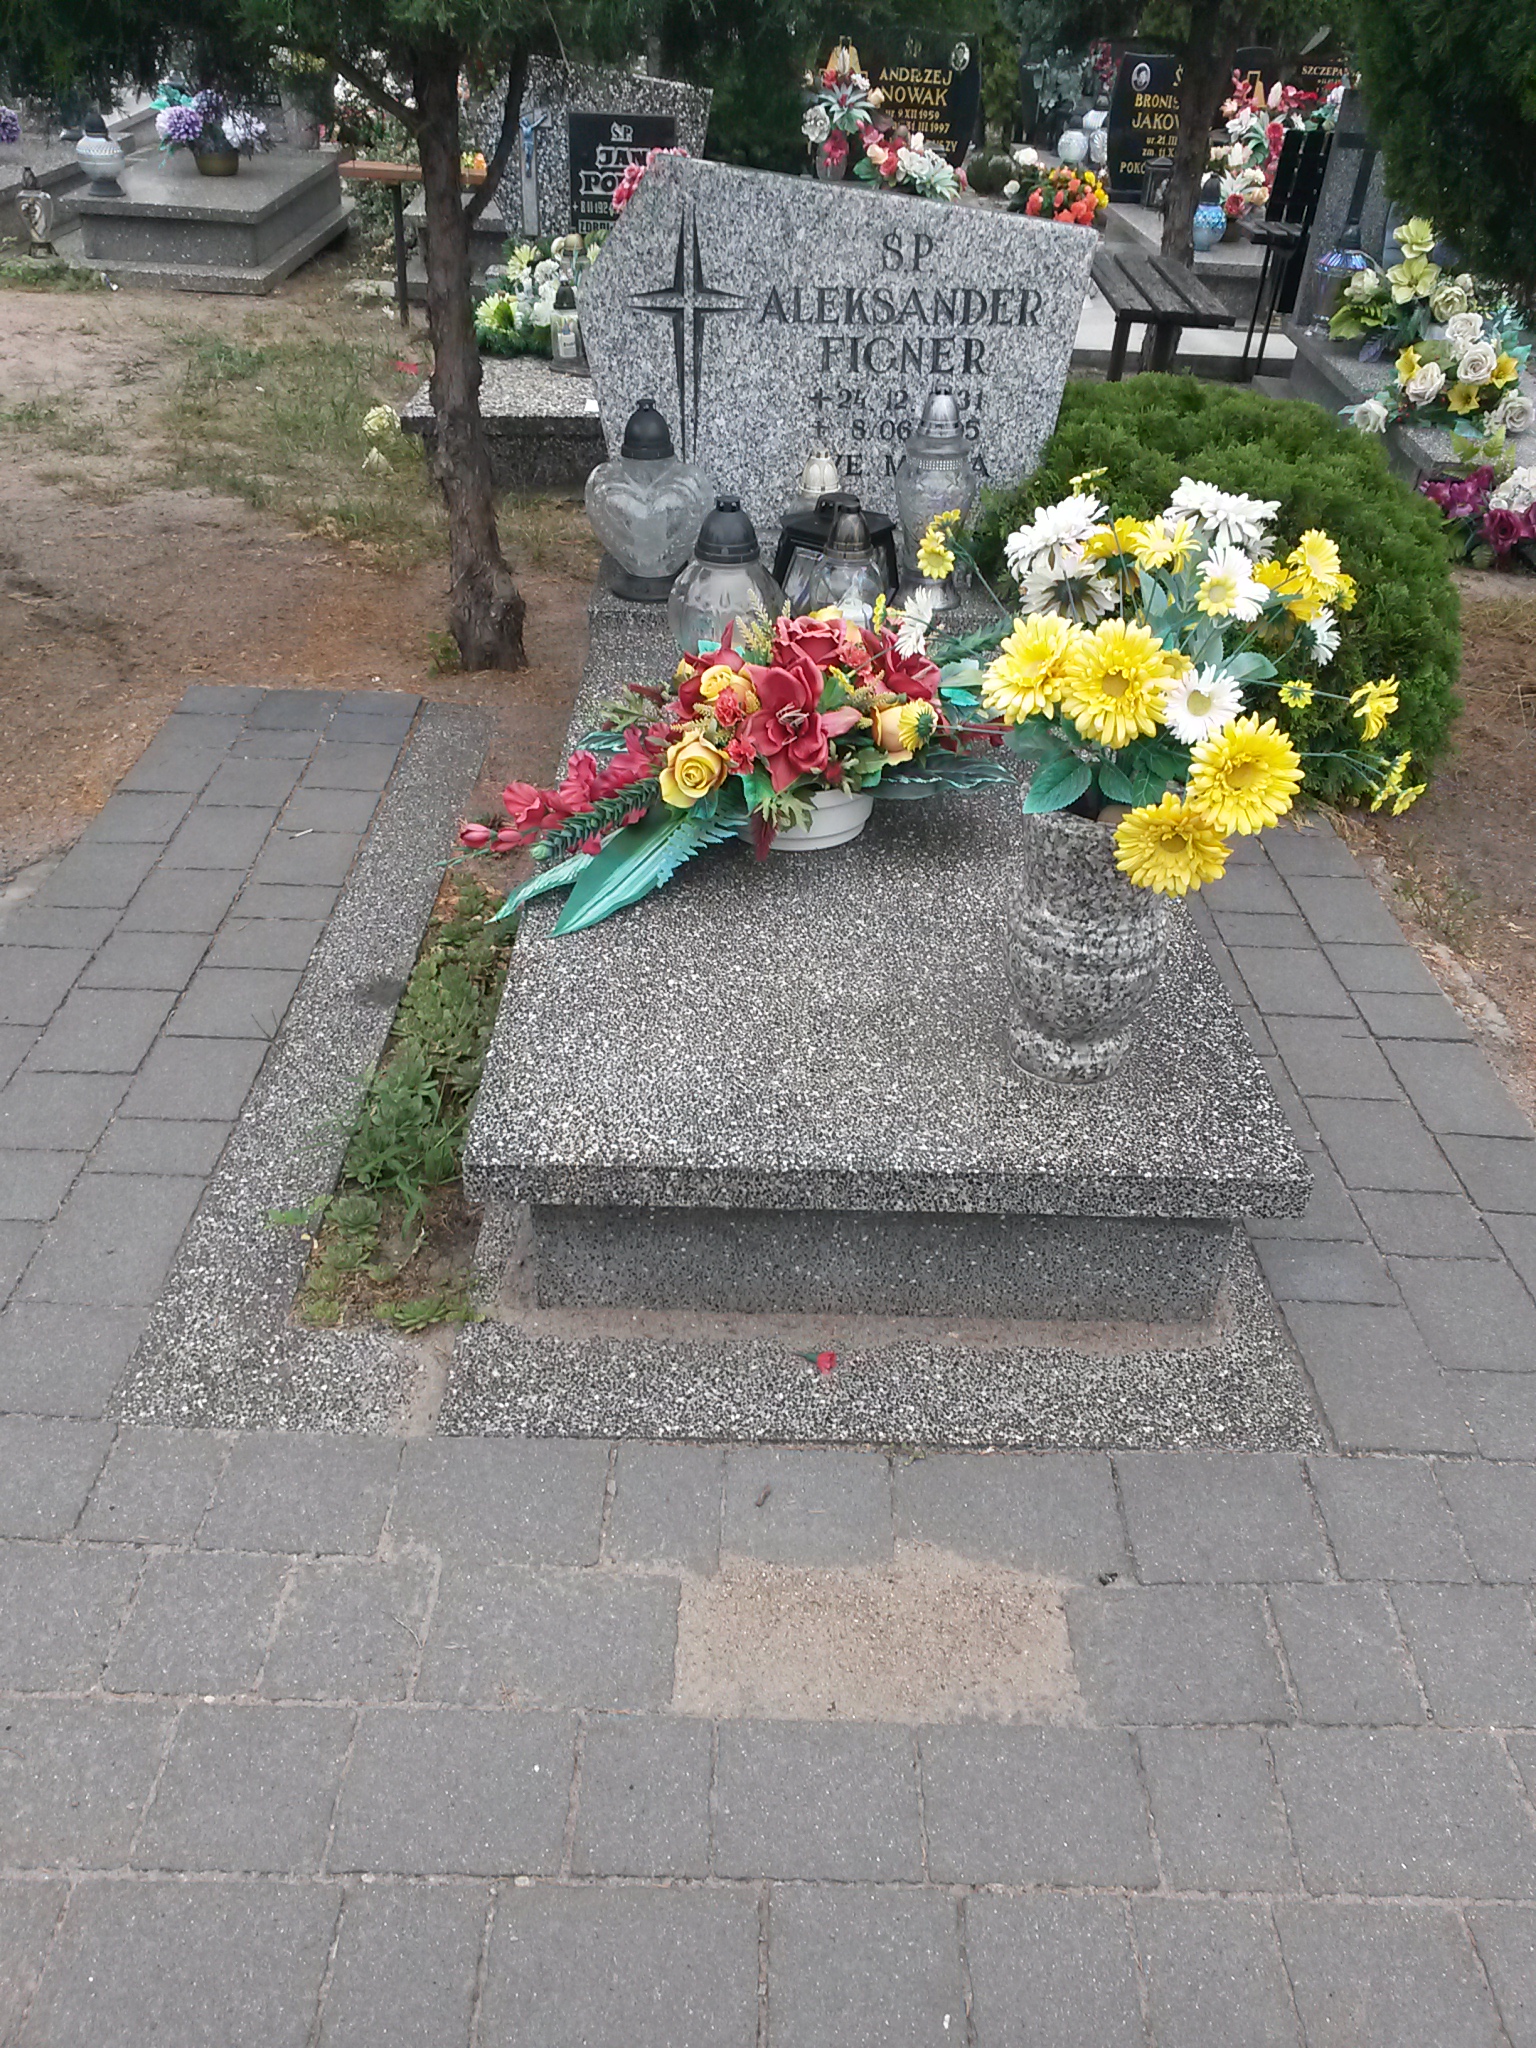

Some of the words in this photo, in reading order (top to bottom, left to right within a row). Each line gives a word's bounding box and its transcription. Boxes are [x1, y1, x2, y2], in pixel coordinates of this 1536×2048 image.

[879, 67, 953, 85] ANDRZEJ
[1302, 65, 1345, 76] SZCZEPA
[882, 85, 948, 106] NOWAK
[1135, 93, 1180, 110] BRONIS
[1132, 112, 1180, 130] JAKO
[595, 144, 651, 168] JAN
[758, 285, 1043, 326] ALEKSANDER
[819, 335, 986, 375] FIGNER
